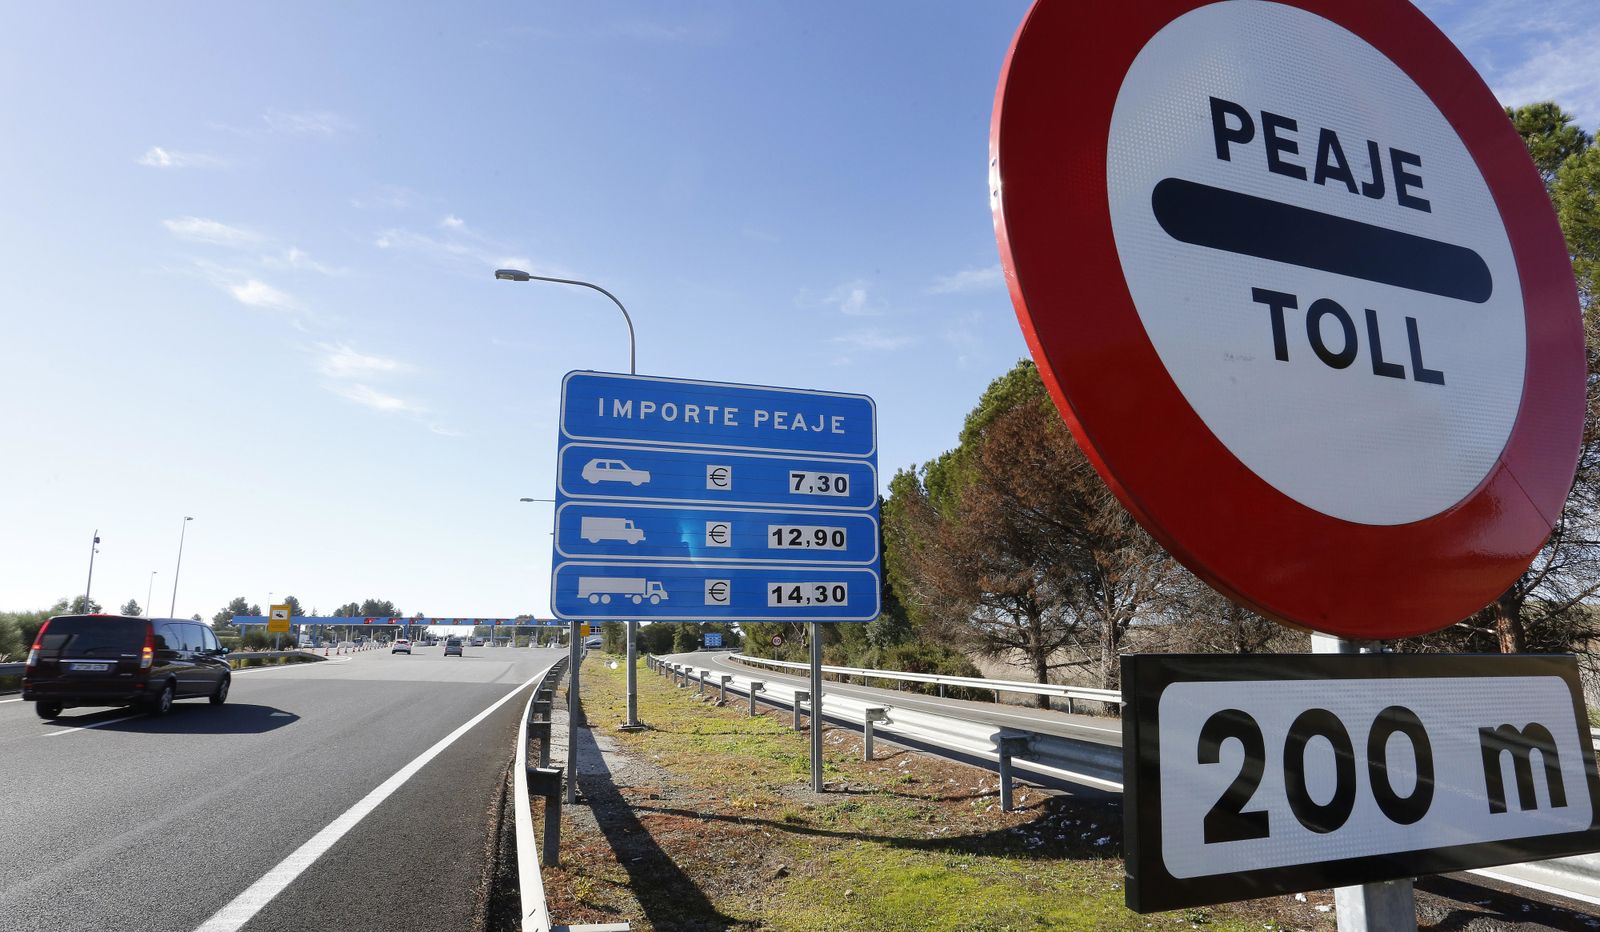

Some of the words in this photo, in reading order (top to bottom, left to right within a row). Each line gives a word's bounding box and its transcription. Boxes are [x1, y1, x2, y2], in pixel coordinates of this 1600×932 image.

[1209, 96, 1432, 214] PEAJE
[1251, 287, 1446, 386] TOLL
[598, 397, 739, 427] IMPORTE
[753, 409, 845, 434] PEAJE
[709, 468, 728, 487] €
[791, 473, 848, 494] 7,30
[708, 524, 728, 544] €
[772, 528, 845, 548] 12,90
[708, 581, 728, 602] €
[771, 584, 846, 606] 14,30
[1197, 705, 1435, 844] 200
[1478, 722, 1568, 814] m
